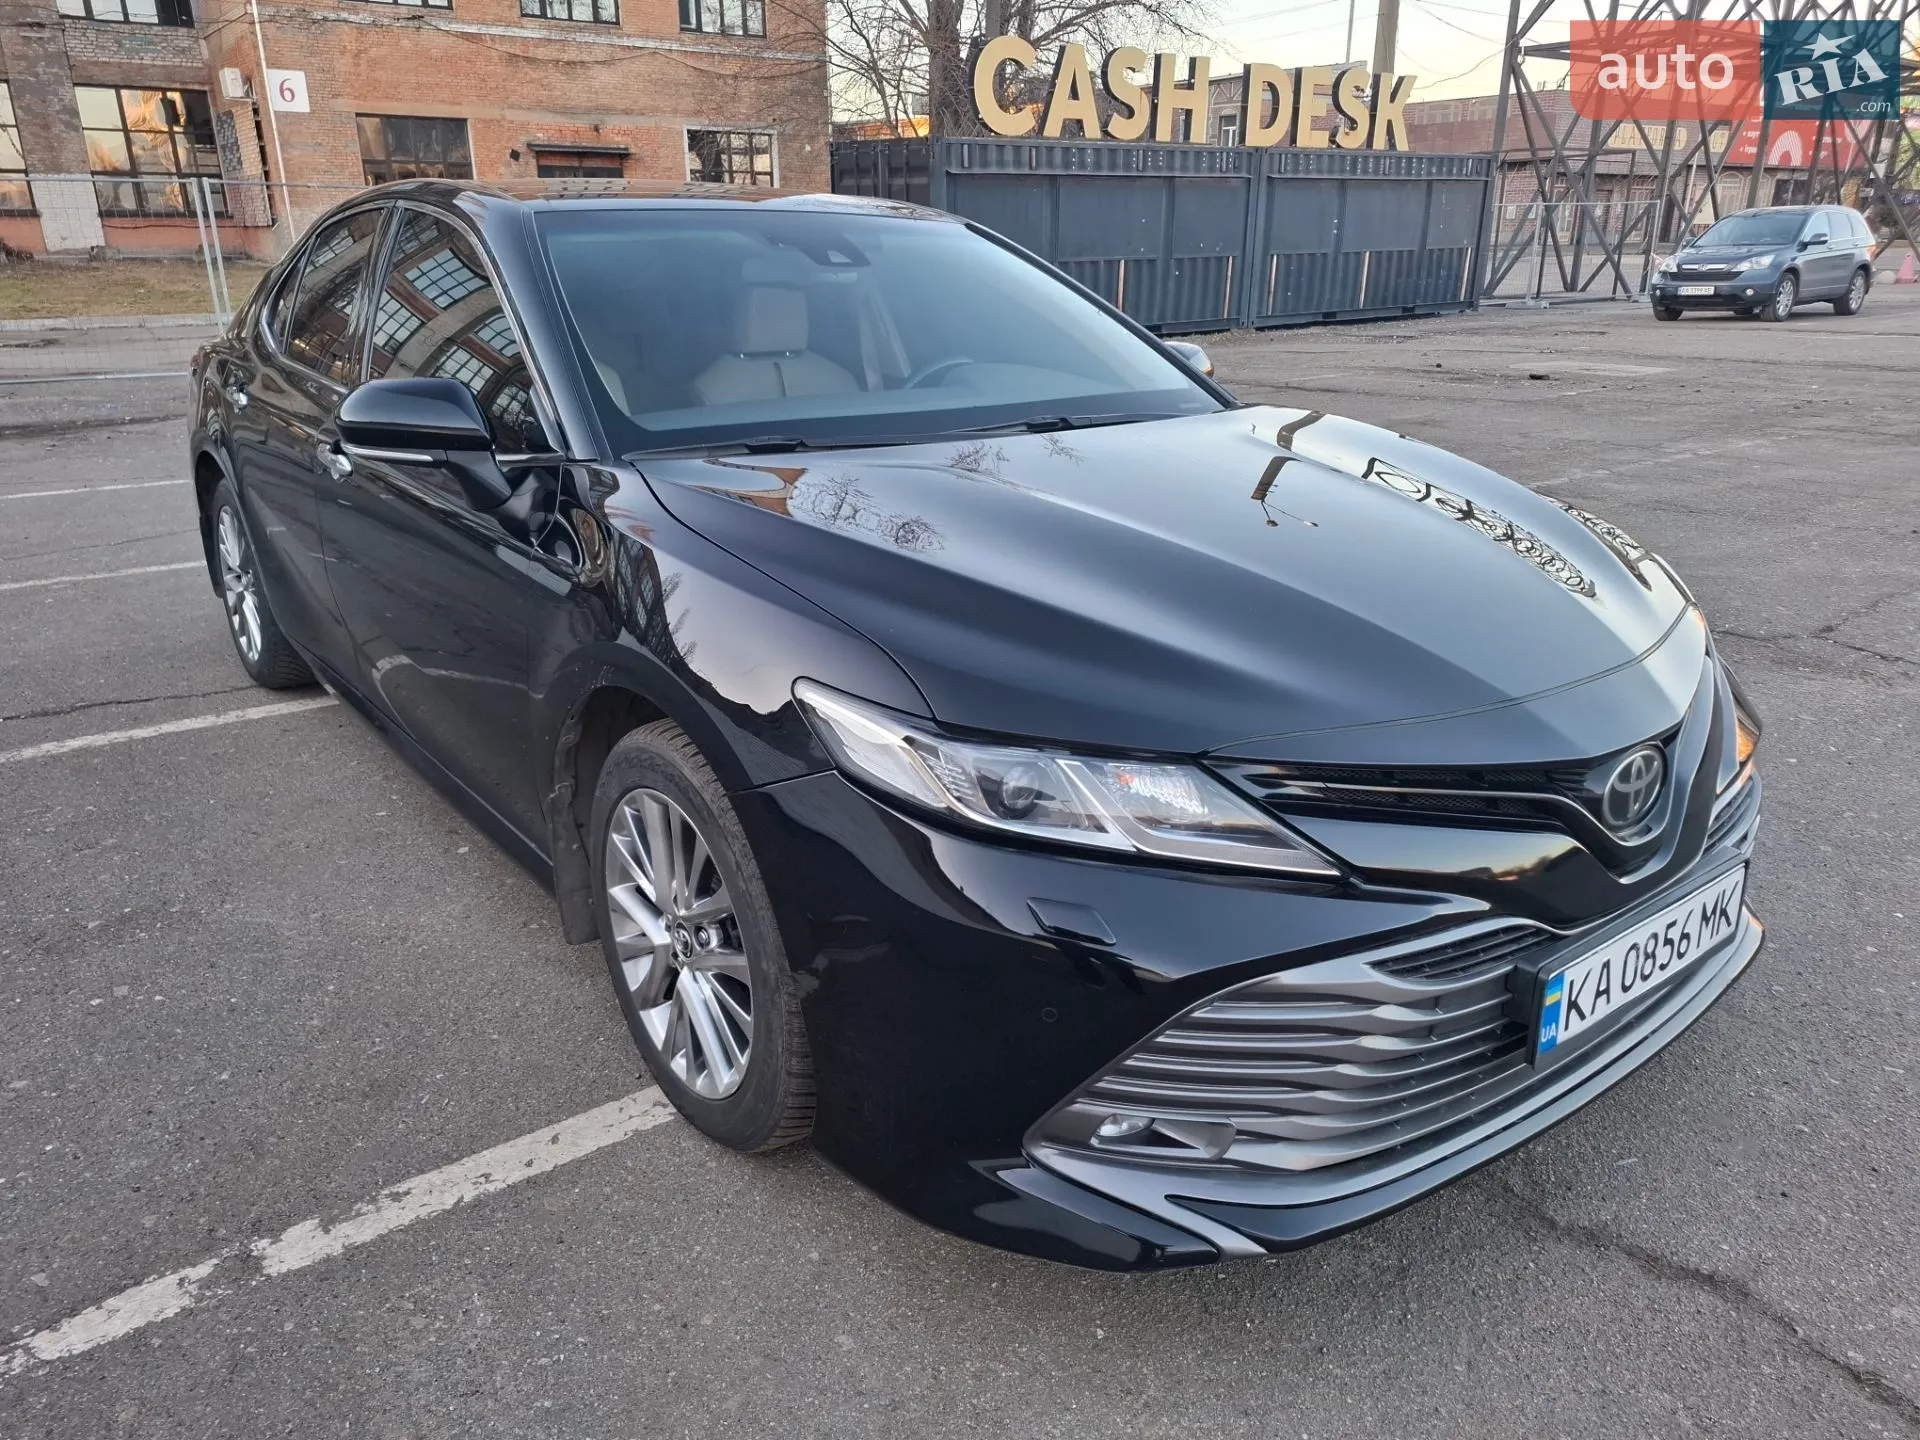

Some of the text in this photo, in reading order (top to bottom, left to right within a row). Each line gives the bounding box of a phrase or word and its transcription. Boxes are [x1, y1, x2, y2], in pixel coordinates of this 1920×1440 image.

[278, 77, 295, 103] 6
[970, 35, 1418, 152] CASH DESK
[1564, 880, 1740, 1032] KA 0856 MK
[1541, 1021, 1556, 1043] UA
